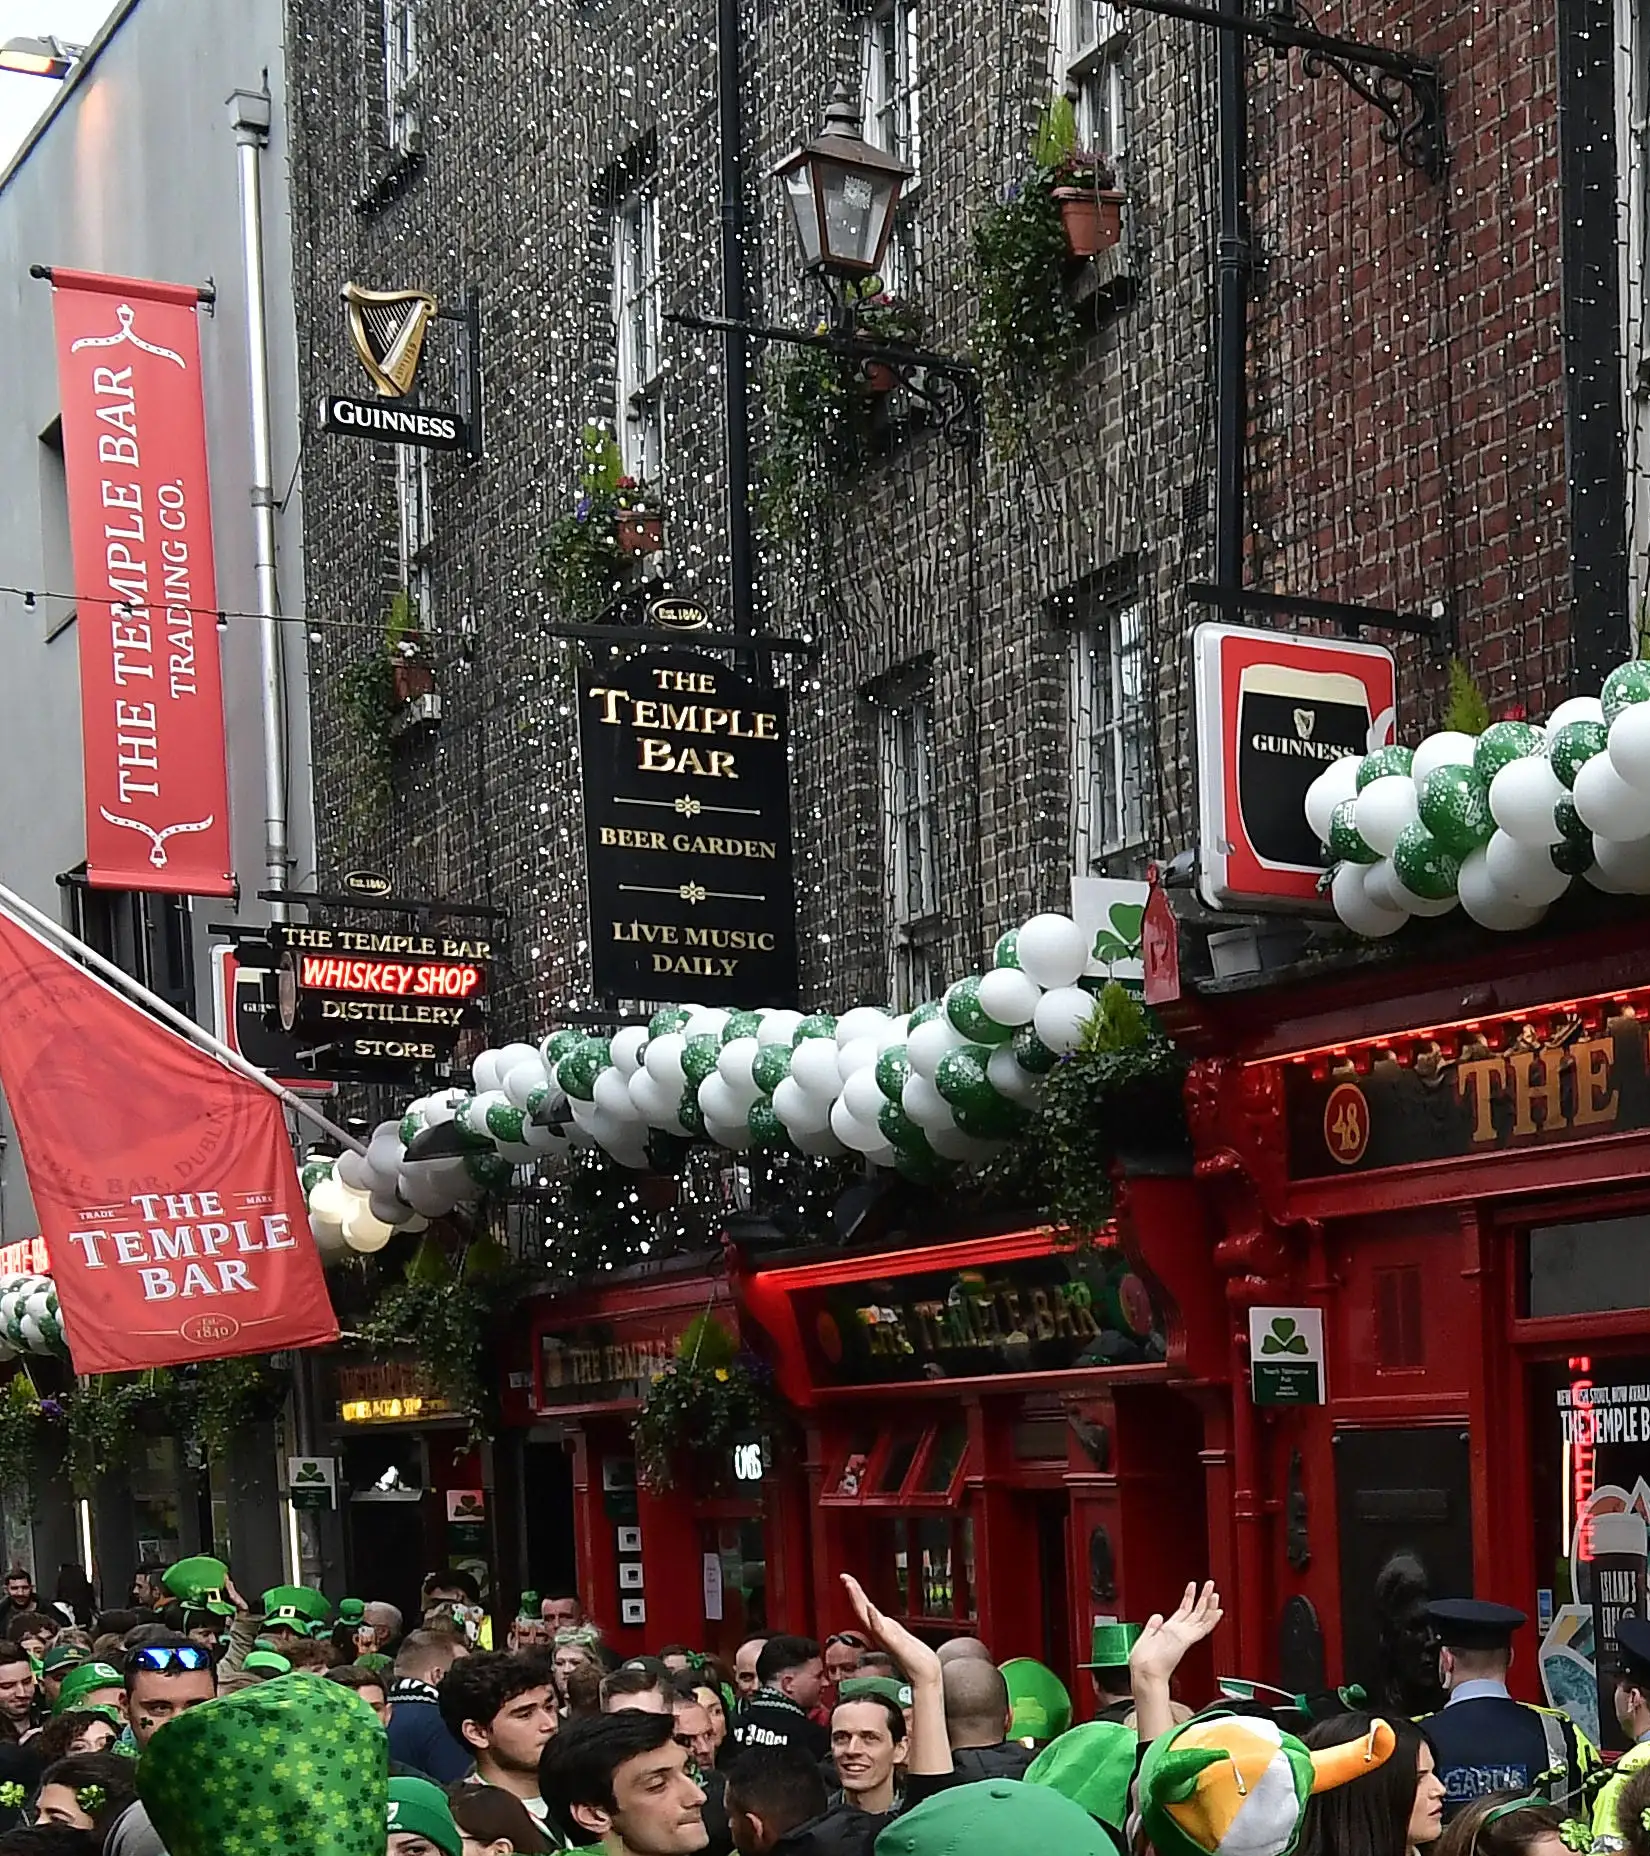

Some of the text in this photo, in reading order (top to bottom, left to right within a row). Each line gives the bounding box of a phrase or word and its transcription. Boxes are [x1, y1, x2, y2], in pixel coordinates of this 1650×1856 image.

[333, 400, 456, 439] GUINNESS
[92, 365, 161, 804] THE TEMPLE BAR
[156, 479, 198, 700] TRADING CO.
[653, 669, 717, 694] THE
[589, 688, 779, 740] TEMPLE
[636, 737, 739, 779] BAR
[600, 827, 777, 859] BEER GARDEN
[282, 927, 492, 960] THE TEMPLE BAR
[612, 921, 776, 951] LIVE MUSIC
[303, 957, 478, 996] WHISKEY SHOP
[653, 954, 738, 977] DAILY
[321, 999, 464, 1026] DISTILLERY
[355, 1039, 436, 1060] STORE
[1459, 1037, 1620, 1143] THE
[1332, 1103, 1361, 1152] 48
[79, 1208, 115, 1222] TRADE
[131, 1191, 224, 1222] THE
[69, 1213, 298, 1269] TEMPLE
[138, 1258, 259, 1302] BAR
[193, 1322, 229, 1339] 1840
[1560, 1409, 1587, 1443] THE
[1589, 1406, 1639, 1444] TEMPLE
